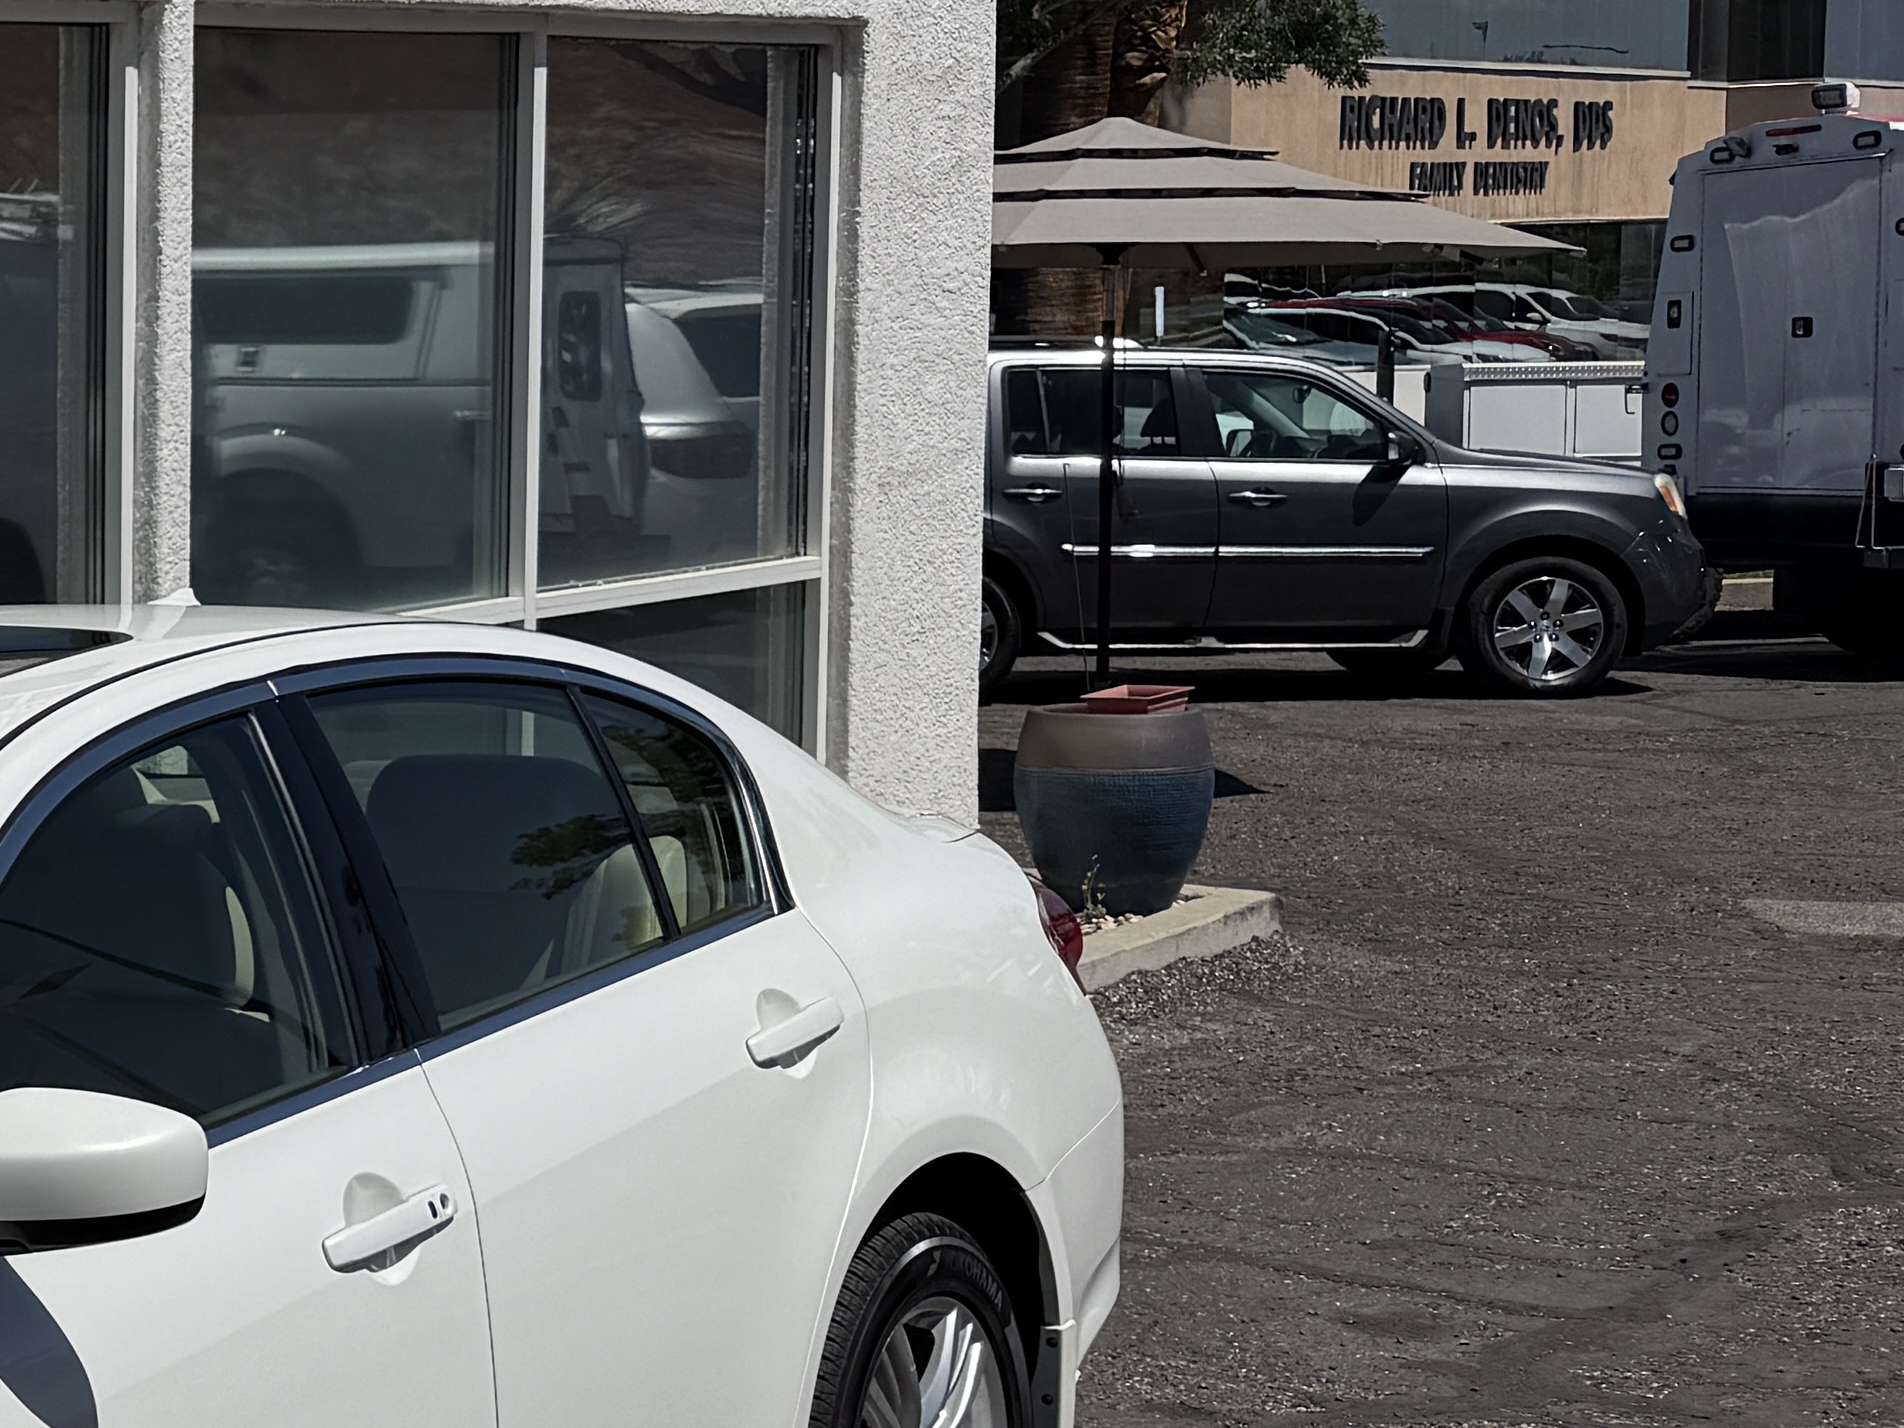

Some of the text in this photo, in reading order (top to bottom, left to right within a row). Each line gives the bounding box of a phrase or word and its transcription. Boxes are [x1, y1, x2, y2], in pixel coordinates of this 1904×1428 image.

[1340, 95, 1446, 150] RICHARD
[1456, 98, 1477, 150] L.
[1573, 100, 1613, 152] DDS
[1409, 161, 1550, 197] FAMILY DENTISTRY
